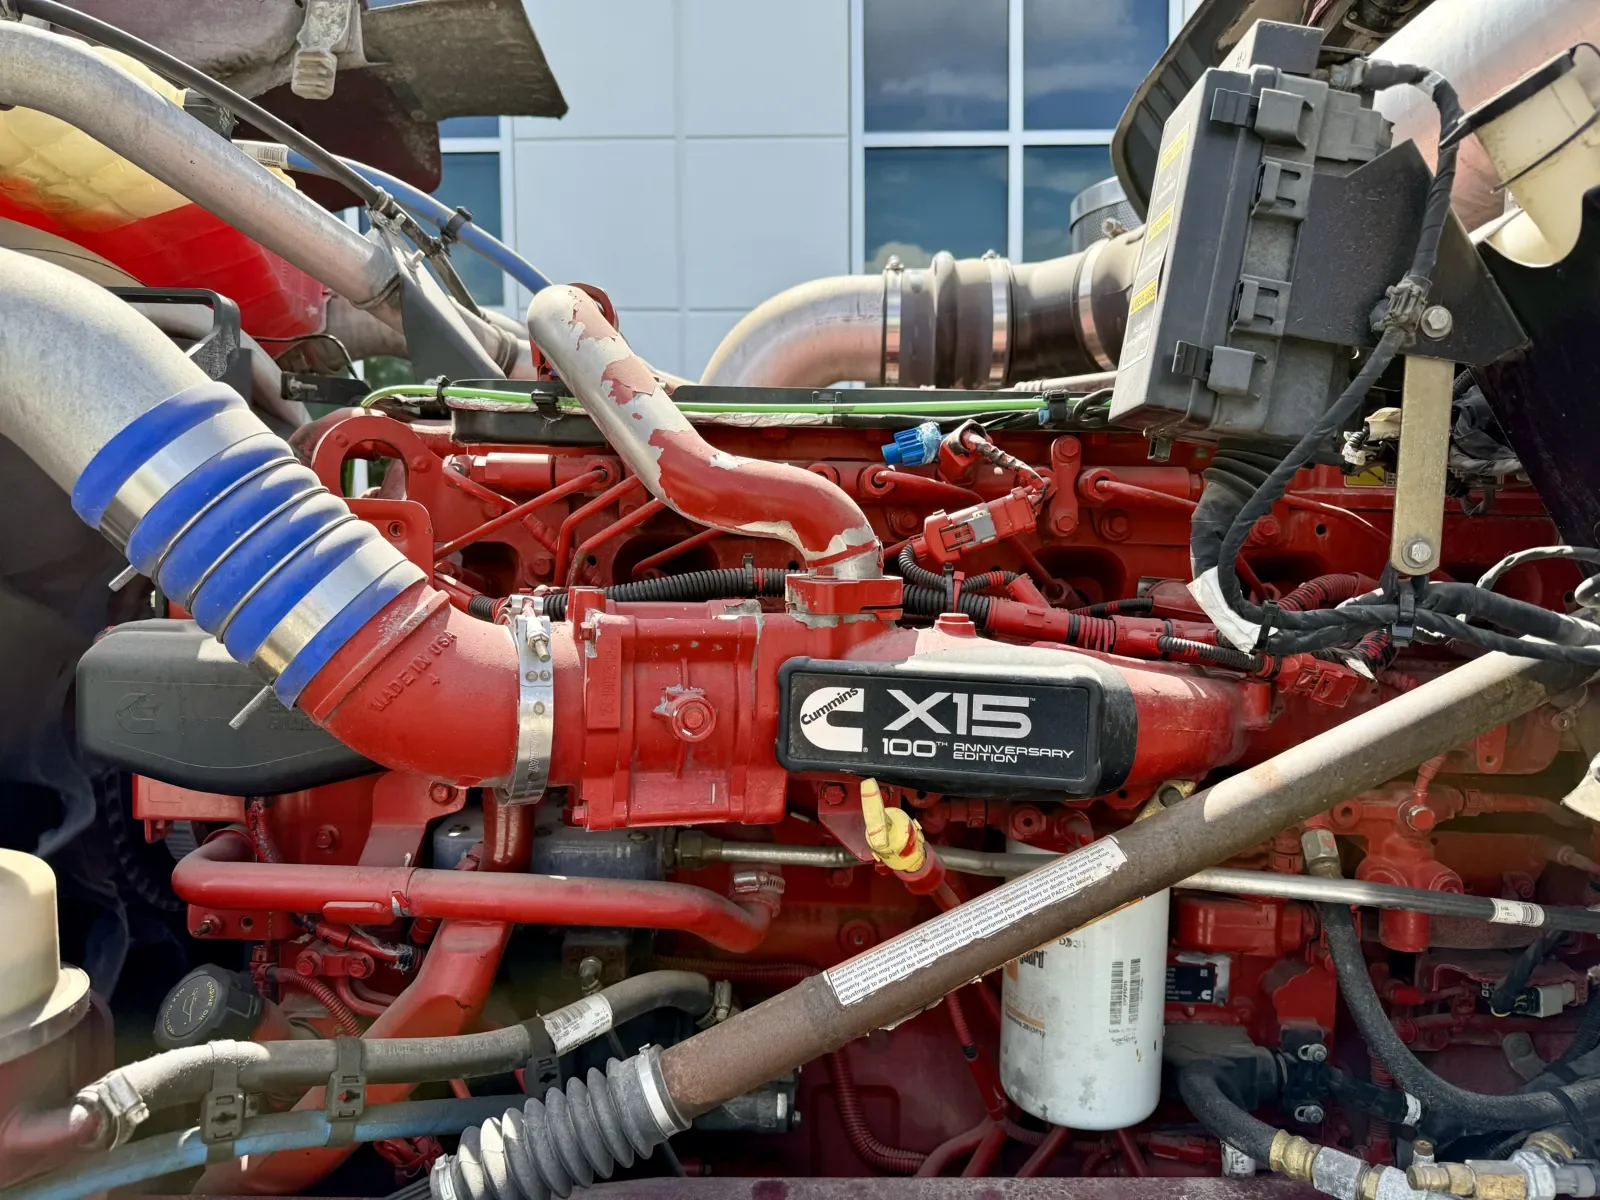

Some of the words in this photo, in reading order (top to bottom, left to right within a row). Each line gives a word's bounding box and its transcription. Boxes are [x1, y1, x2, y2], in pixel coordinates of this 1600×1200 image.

[370, 668, 416, 712] MADE
[409, 654, 432, 674] IN
[428, 629, 458, 656] USA
[800, 687, 859, 726] Cummins
[882, 688, 1033, 739] X15
[953, 742, 1075, 759] ANNIVERSARY
[953, 751, 1018, 764] EDITION
[1068, 854, 1090, 867] steering
[835, 977, 853, 988] sensor
[853, 968, 868, 979] must
[972, 903, 1000, 922] performed
[1009, 890, 1031, 903] stability
[1030, 879, 1049, 892] control
[1049, 871, 1068, 883] system
[1069, 865, 1079, 873] will
[1087, 851, 1109, 864] function
[840, 983, 871, 1002] adjustment
[888, 969, 900, 980] part
[916, 951, 939, 964] steering
[938, 941, 958, 953] system
[958, 933, 973, 944] must
[980, 915, 1008, 934] performed
[1023, 894, 1051, 911] authorized
[1050, 882, 1075, 897] PACCAR
[862, 971, 878, 982] which
[890, 957, 907, 968] result
[916, 947, 929, 955] loss
[935, 933, 955, 946] control
[961, 925, 973, 935] your
[974, 915, 993, 927] vehicle
[1004, 897, 1027, 914] personal
[1026, 891, 1043, 901] injury
[198, 1009, 209, 1022] OIL
